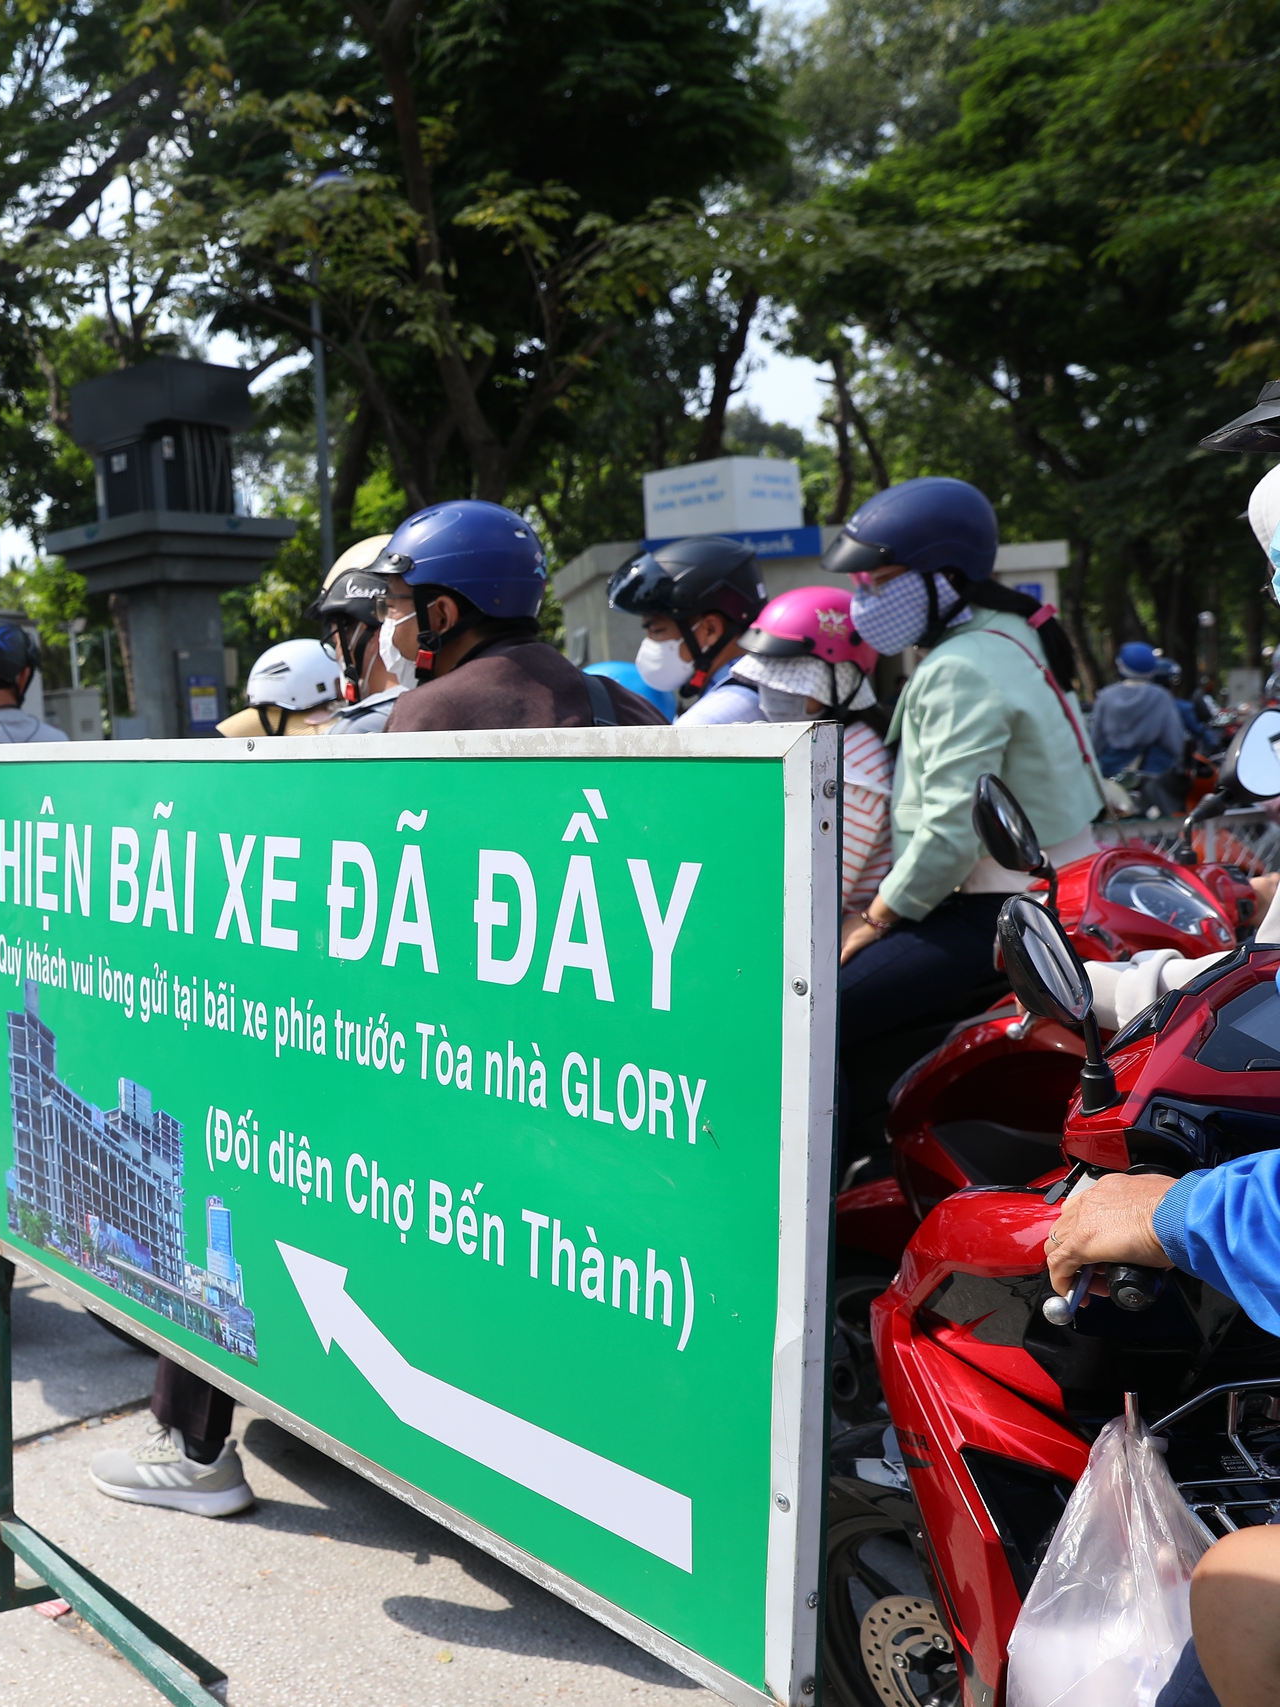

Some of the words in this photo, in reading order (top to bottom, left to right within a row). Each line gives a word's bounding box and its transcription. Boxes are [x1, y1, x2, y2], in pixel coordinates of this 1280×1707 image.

[344, 578, 387, 599] Vesp
[109, 801, 197, 935] BÃI
[214, 832, 301, 952] XE
[326, 809, 439, 975] ĐÃ
[473, 788, 703, 1012] ĐẦY
[25, 940, 67, 989] khách
[71, 953, 94, 996] vui
[97, 955, 135, 1019] lòng
[139, 962, 168, 1023] gửi
[173, 974, 197, 1031] tại
[204, 979, 236, 1034] bãi
[242, 998, 268, 1041] xe
[275, 997, 327, 1058] phía
[334, 1009, 407, 1075] trước
[415, 1021, 473, 1091] Tòa
[484, 1040, 548, 1109] nhà
[561, 1050, 707, 1145] GLORY
[205, 1105, 260, 1175] (Đối
[268, 1129, 333, 1206] diện
[345, 1153, 415, 1244] Chợ
[428, 1178, 505, 1267] Bến
[521, 1208, 695, 1352] Thành)
